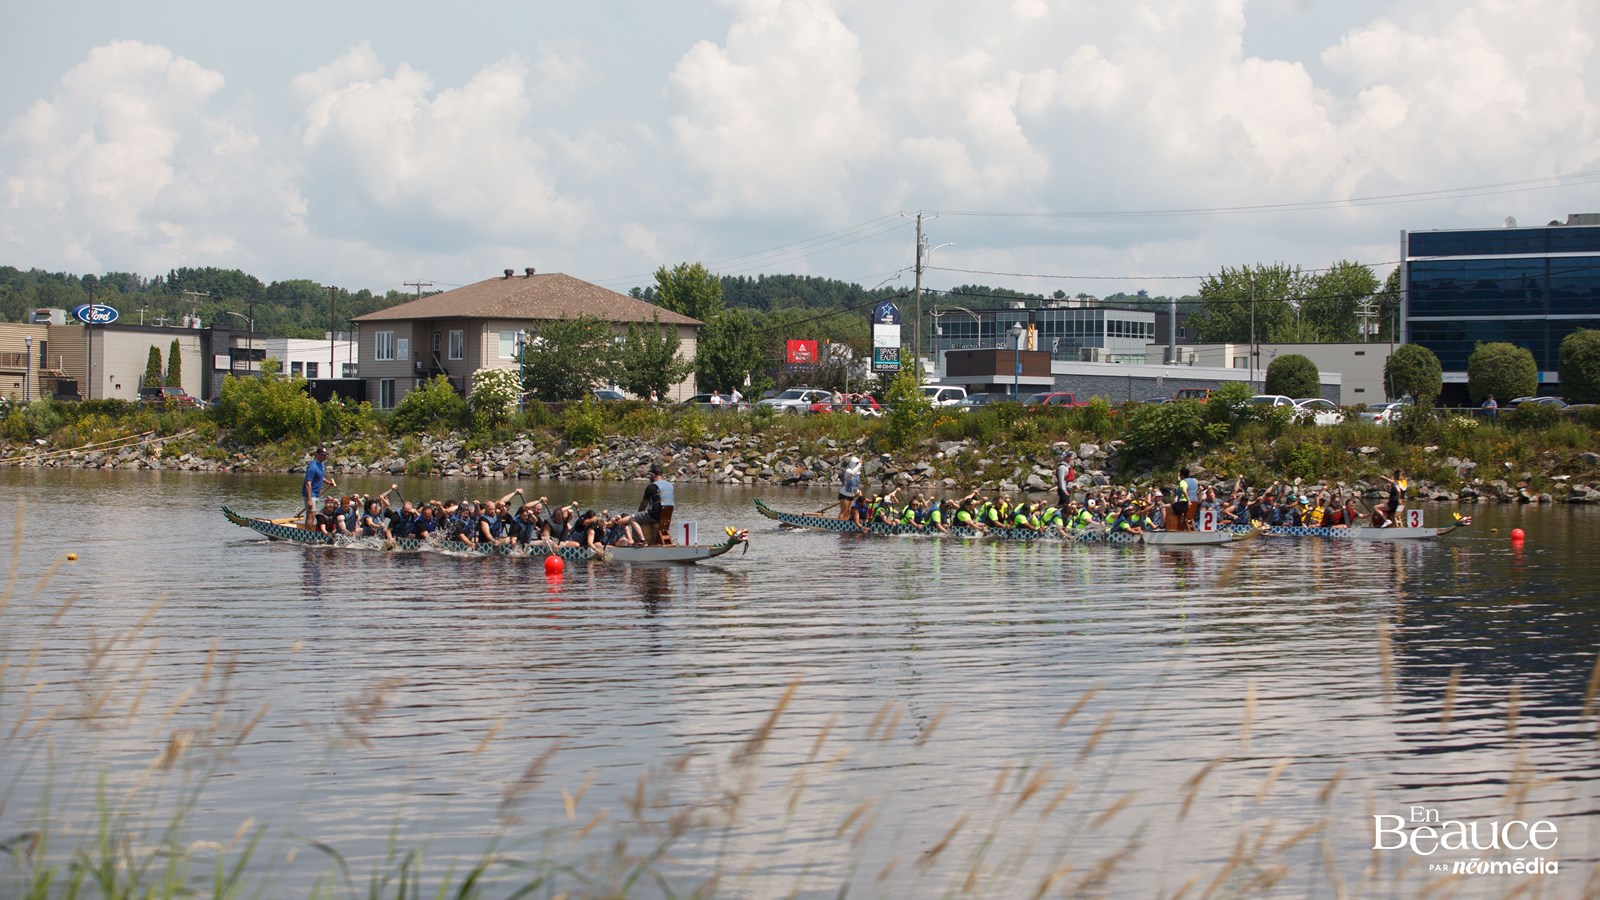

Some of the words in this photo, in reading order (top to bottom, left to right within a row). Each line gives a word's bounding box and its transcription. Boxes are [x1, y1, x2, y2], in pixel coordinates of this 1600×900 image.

[85, 307, 110, 321] Ford
[1204, 512, 1213, 531] 2
[1411, 511, 1419, 528] 3
[683, 523, 690, 546] 1
